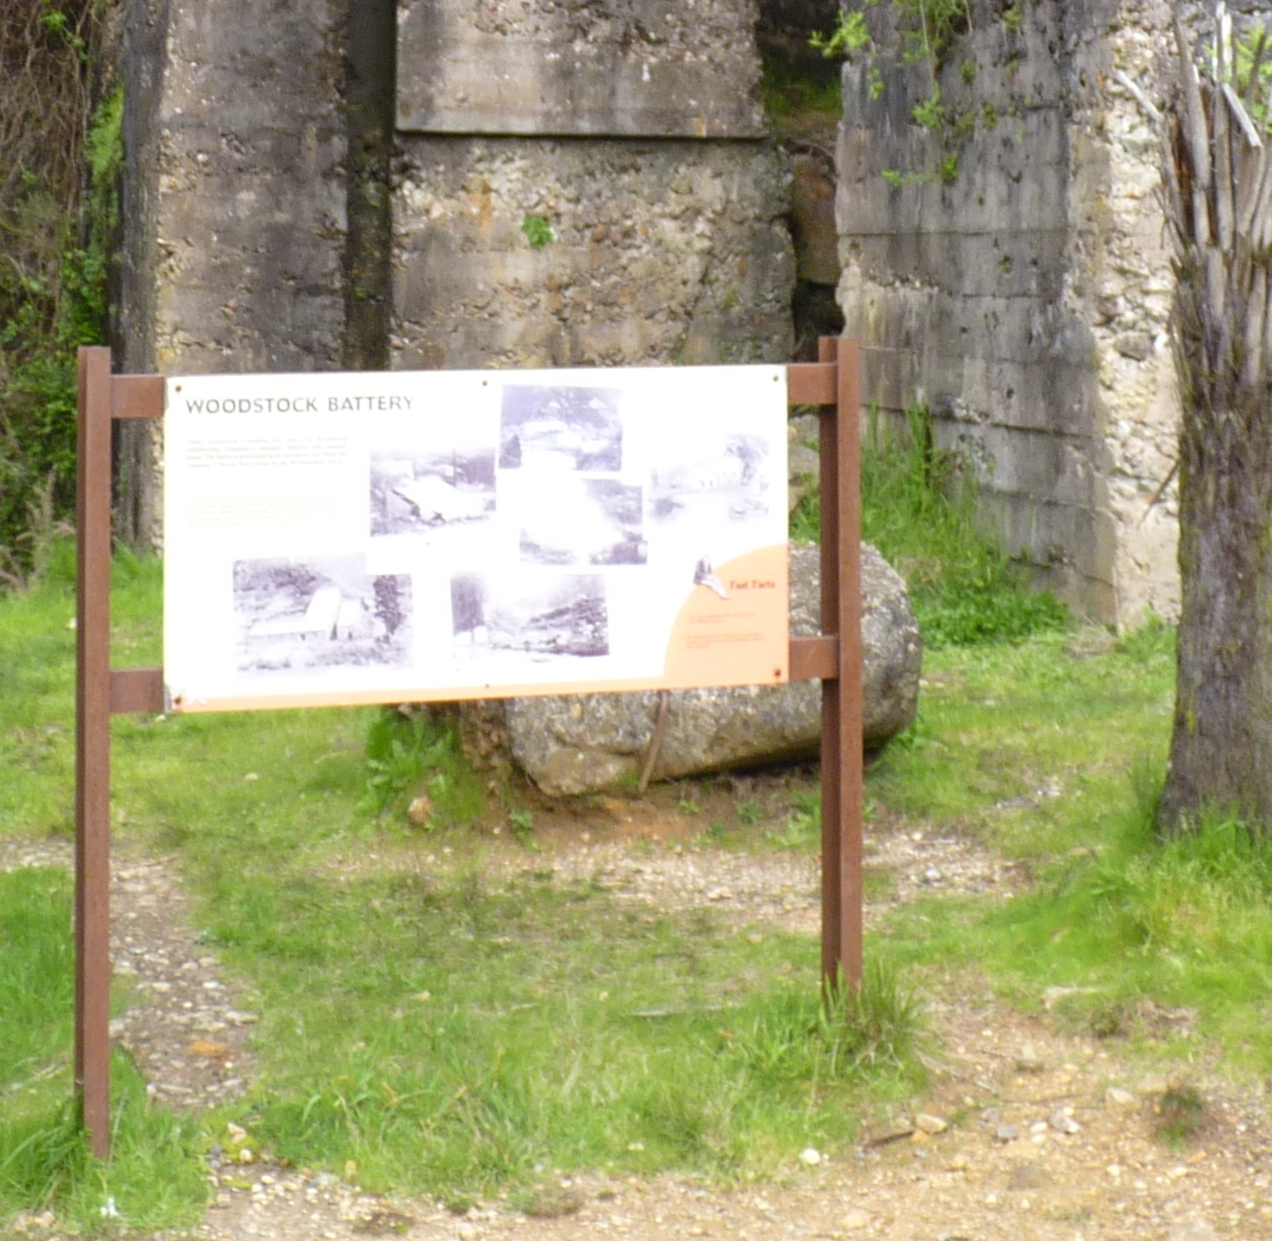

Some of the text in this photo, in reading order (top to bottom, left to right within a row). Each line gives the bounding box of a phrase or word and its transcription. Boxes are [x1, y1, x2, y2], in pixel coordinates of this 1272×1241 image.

[185, 395, 415, 414] WOODSTOCK BATTERY
[729, 580, 775, 591] Fast Facts
